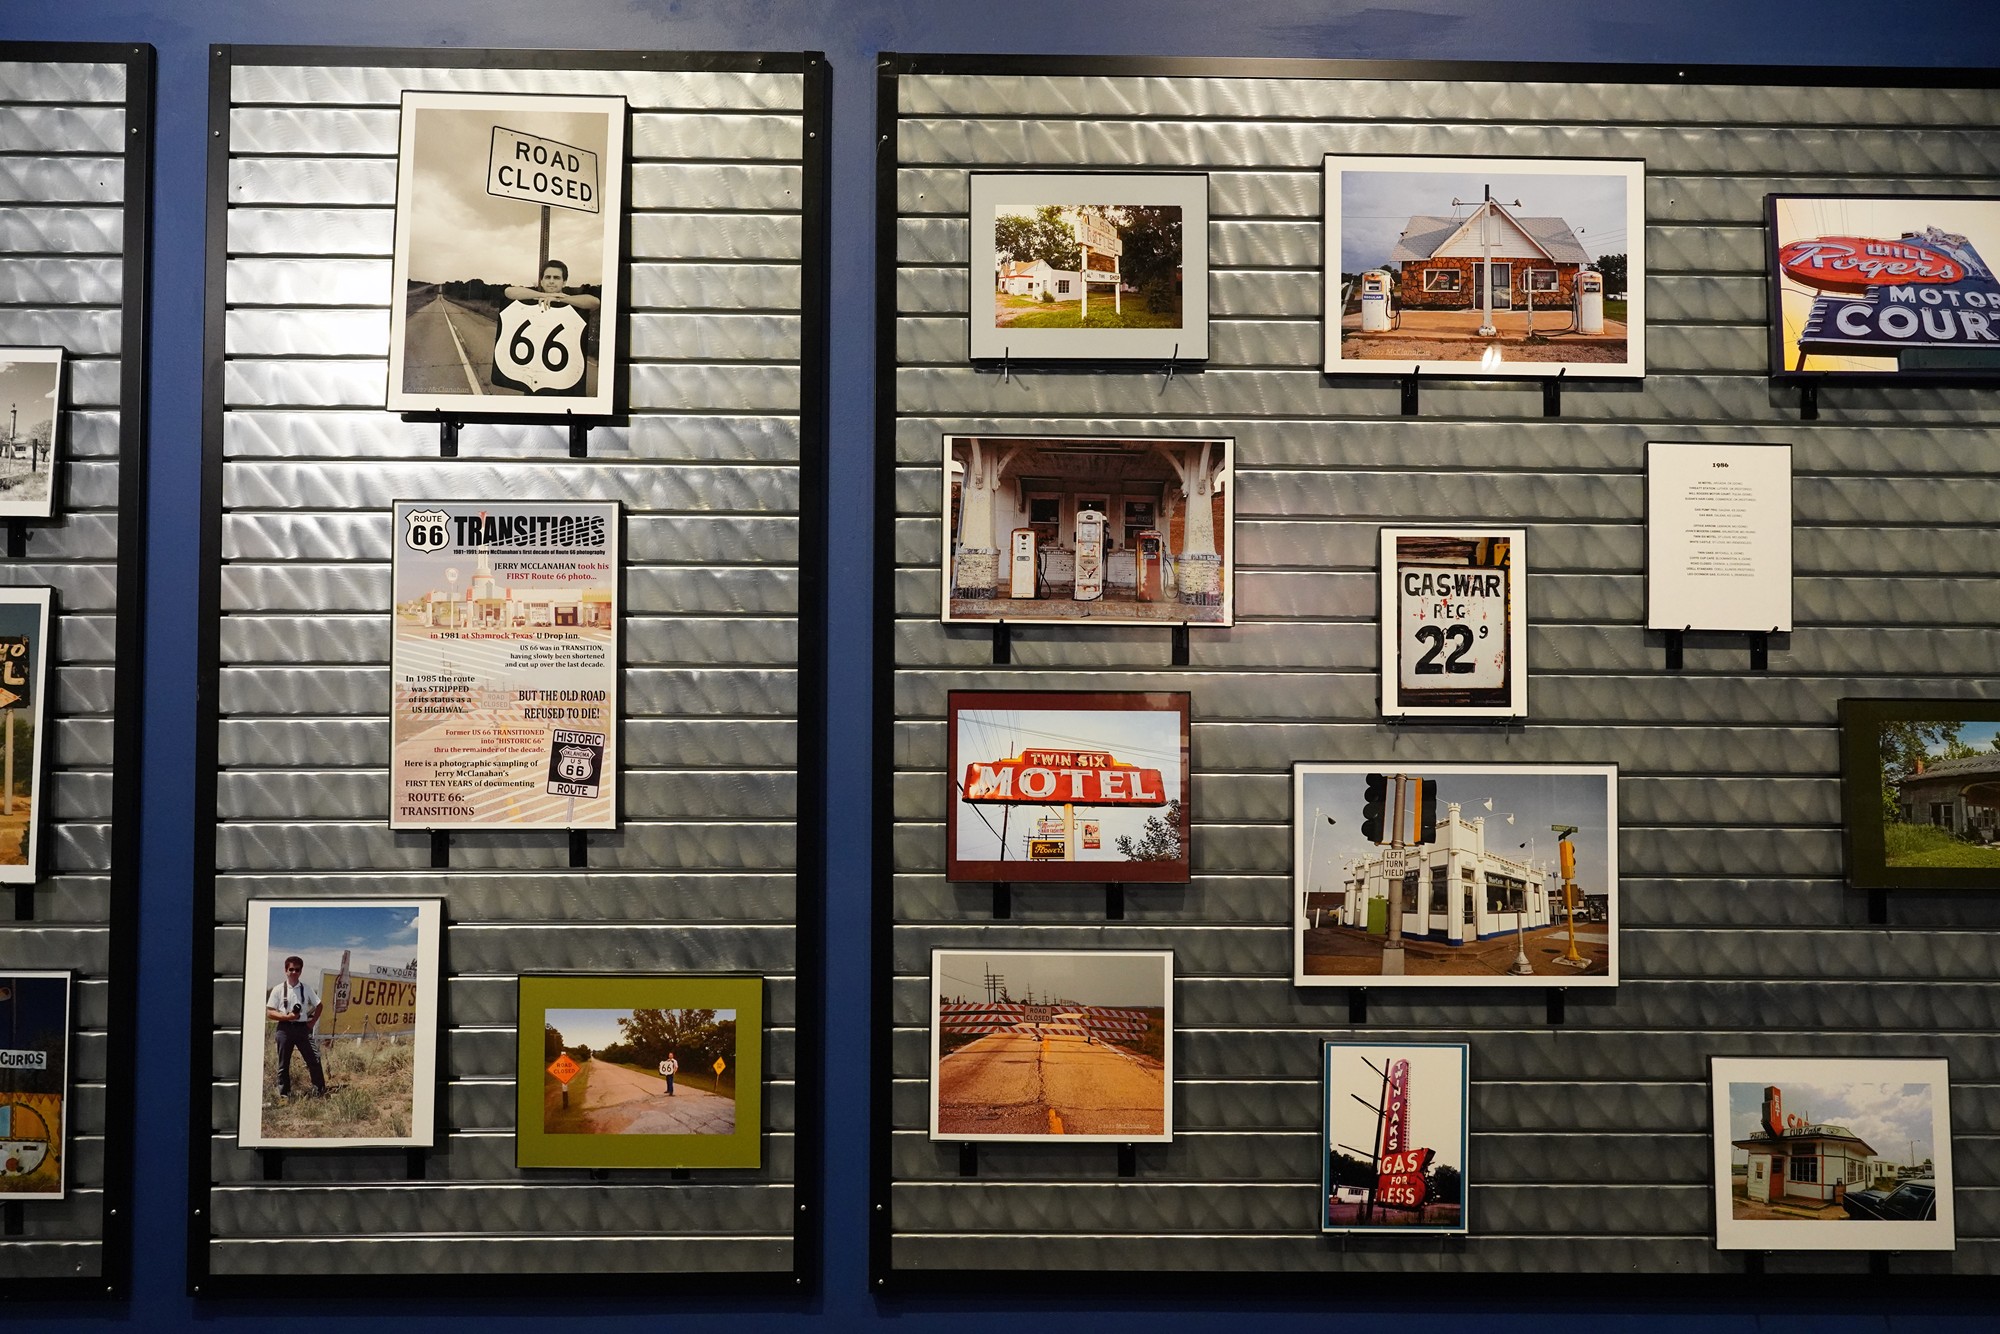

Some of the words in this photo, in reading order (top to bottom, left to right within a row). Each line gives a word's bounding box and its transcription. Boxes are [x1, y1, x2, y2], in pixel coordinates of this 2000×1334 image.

[516, 141, 580, 173] ROAD
[498, 166, 592, 202] CLOSED
[1867, 244, 1933, 260] WILL
[1788, 243, 1954, 278] Rogers
[510, 319, 569, 372] 66
[413, 525, 443, 545] 66
[454, 515, 605, 547] TRANSITIONS
[1434, 604, 1466, 618] REG
[519, 691, 537, 701] BUT
[540, 691, 558, 701] THE
[560, 691, 578, 701] OLD
[581, 691, 606, 701] ROAD
[525, 708, 564, 719] REFUSED
[567, 708, 578, 719] TO
[582, 708, 599, 719] DIE!
[557, 732, 601, 745] HISTORIC
[1031, 754, 1071, 766] TWIN
[1078, 754, 1106, 767] SIX
[566, 765, 584, 776] 66
[557, 784, 588, 795] ROUTE
[978, 766, 1156, 799] MOTEL
[408, 793, 445, 801] ROUTE
[448, 793, 465, 801] 66:
[1385, 869, 1404, 877] YIELD
[376, 1012, 398, 1024] COLD
[1, 1052, 44, 1066] CURIOS
[662, 1063, 671, 1072] 66
[1393, 1062, 1402, 1097] TWIN
[1389, 1102, 1400, 1150] OAKS
[1382, 1153, 1418, 1174] GAS
[1380, 1188, 1415, 1204] LESS
